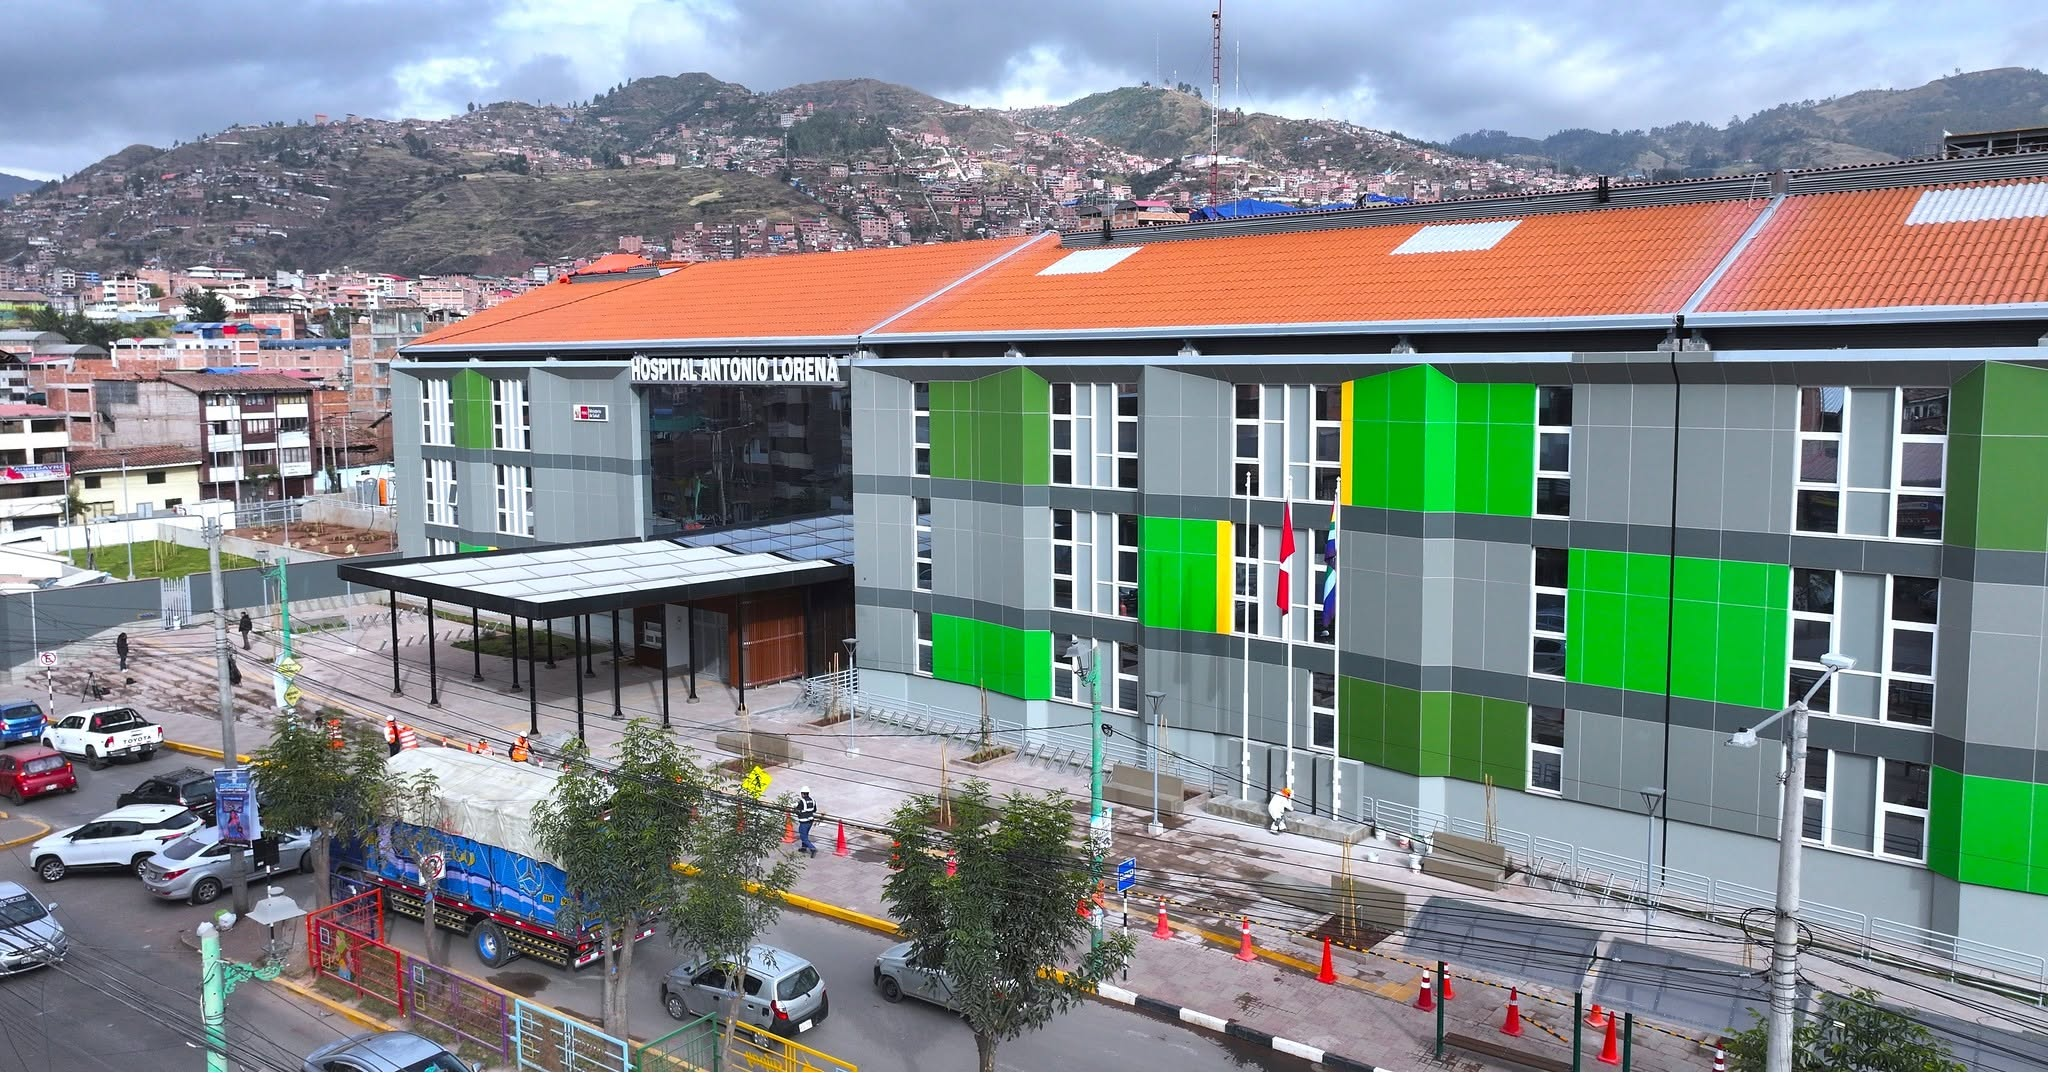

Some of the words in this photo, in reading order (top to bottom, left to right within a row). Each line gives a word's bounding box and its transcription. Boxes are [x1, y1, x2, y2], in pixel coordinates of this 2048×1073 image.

[631, 357, 699, 382] HOSPITAL
[701, 356, 769, 382] ANTONIO
[773, 356, 840, 382] LORENA
[123, 735, 152, 744] TOYOTA
